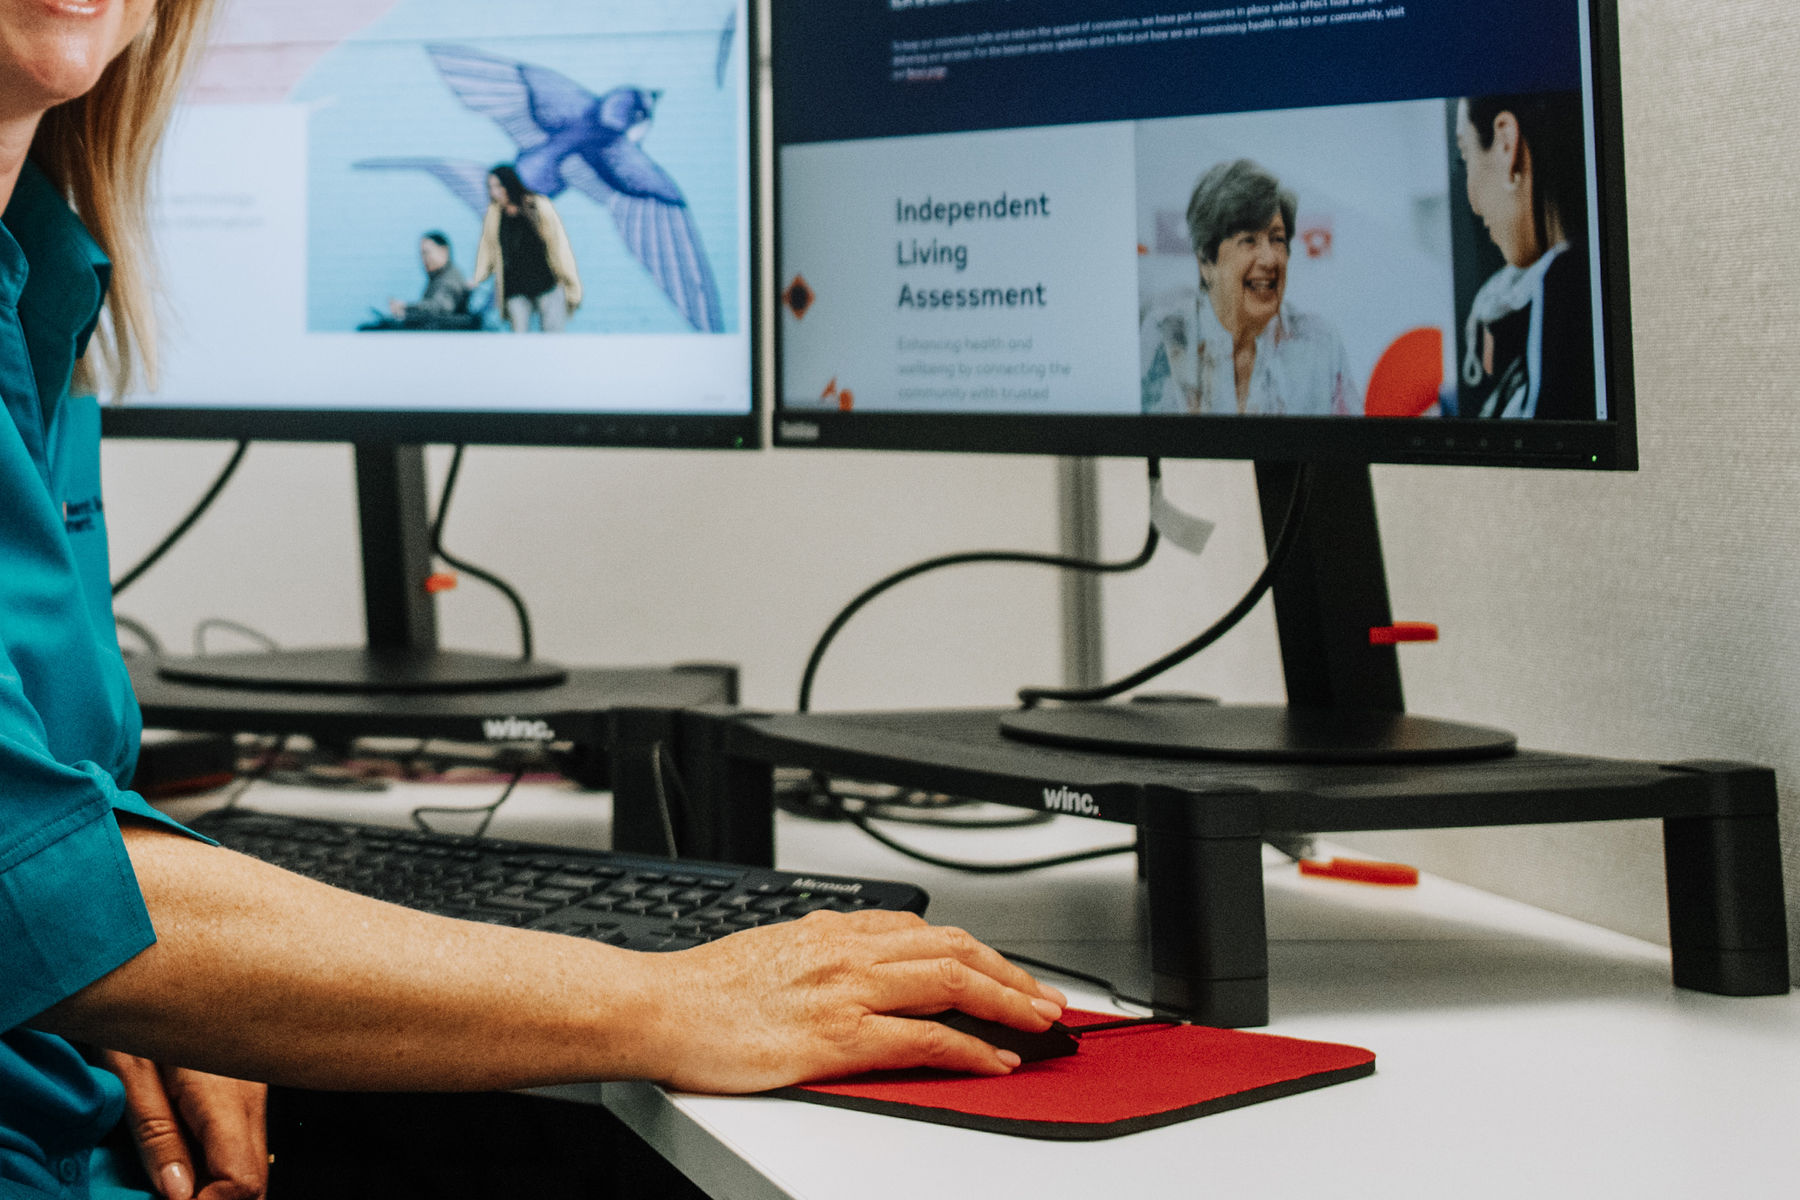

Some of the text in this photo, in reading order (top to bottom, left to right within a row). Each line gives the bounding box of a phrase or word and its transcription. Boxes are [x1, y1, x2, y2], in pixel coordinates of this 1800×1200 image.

[1247, 3, 1270, 18] place
[1272, 1, 1298, 14] which
[1248, 17, 1277, 31] health
[1279, 15, 1299, 27] risks
[1301, 14, 1311, 25] to
[1313, 13, 1328, 24] our
[1385, 4, 1405, 18] visit
[897, 190, 1050, 226] Independent
[897, 237, 967, 271] Living
[898, 282, 1047, 308] Assessment
[1007, 335, 1033, 350] and
[958, 363, 972, 378] by
[975, 362, 1046, 379] connecting
[1049, 361, 1072, 375] the
[1042, 785, 1100, 816] winc.
[792, 878, 862, 895] Microsoft
